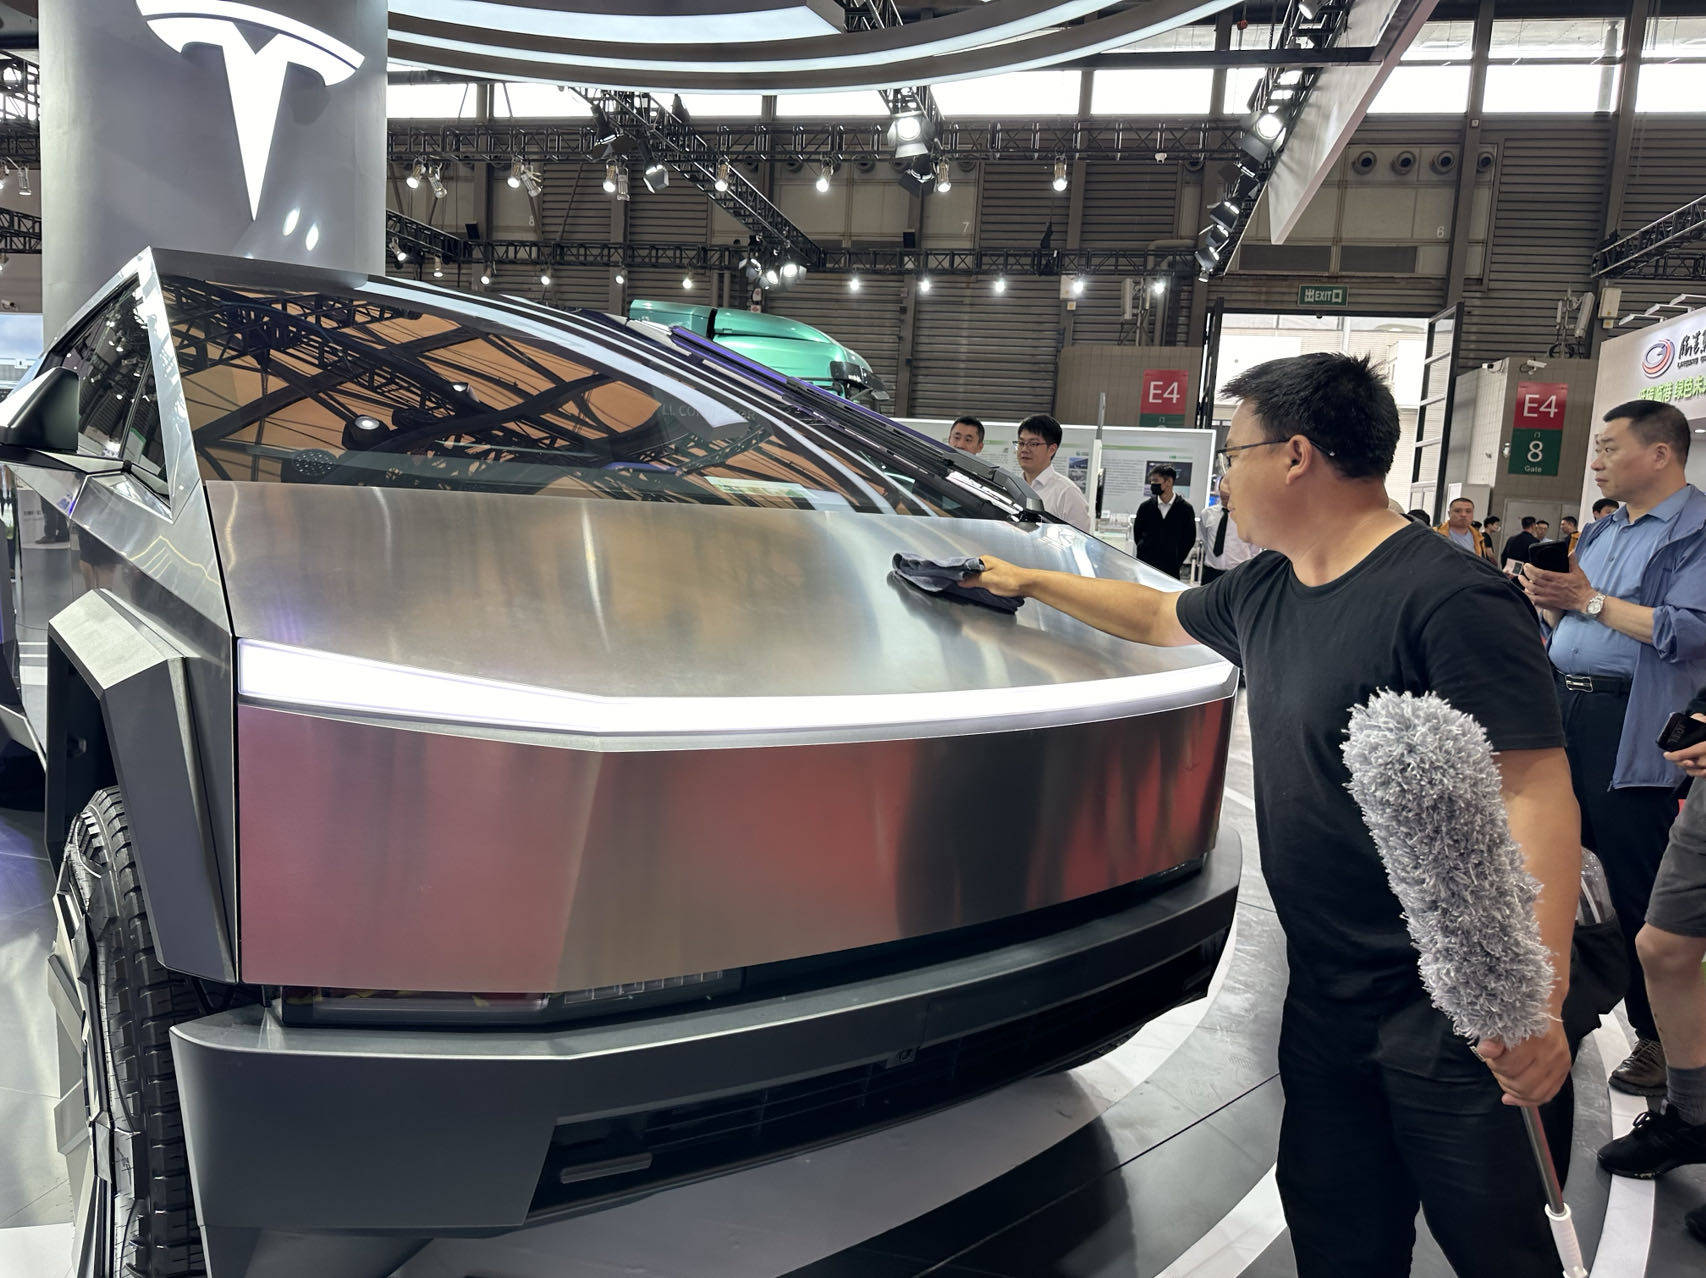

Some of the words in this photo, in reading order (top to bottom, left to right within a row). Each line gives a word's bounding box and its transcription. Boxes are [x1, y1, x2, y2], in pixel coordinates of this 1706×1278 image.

[962, 221, 969, 233] 7
[1437, 225, 1445, 239] 6
[1315, 290, 1332, 301] EXIT
[1149, 381, 1181, 403] E4
[1523, 394, 1558, 418] E4
[1527, 440, 1543, 462] 8
[1524, 464, 1542, 473] Gate
